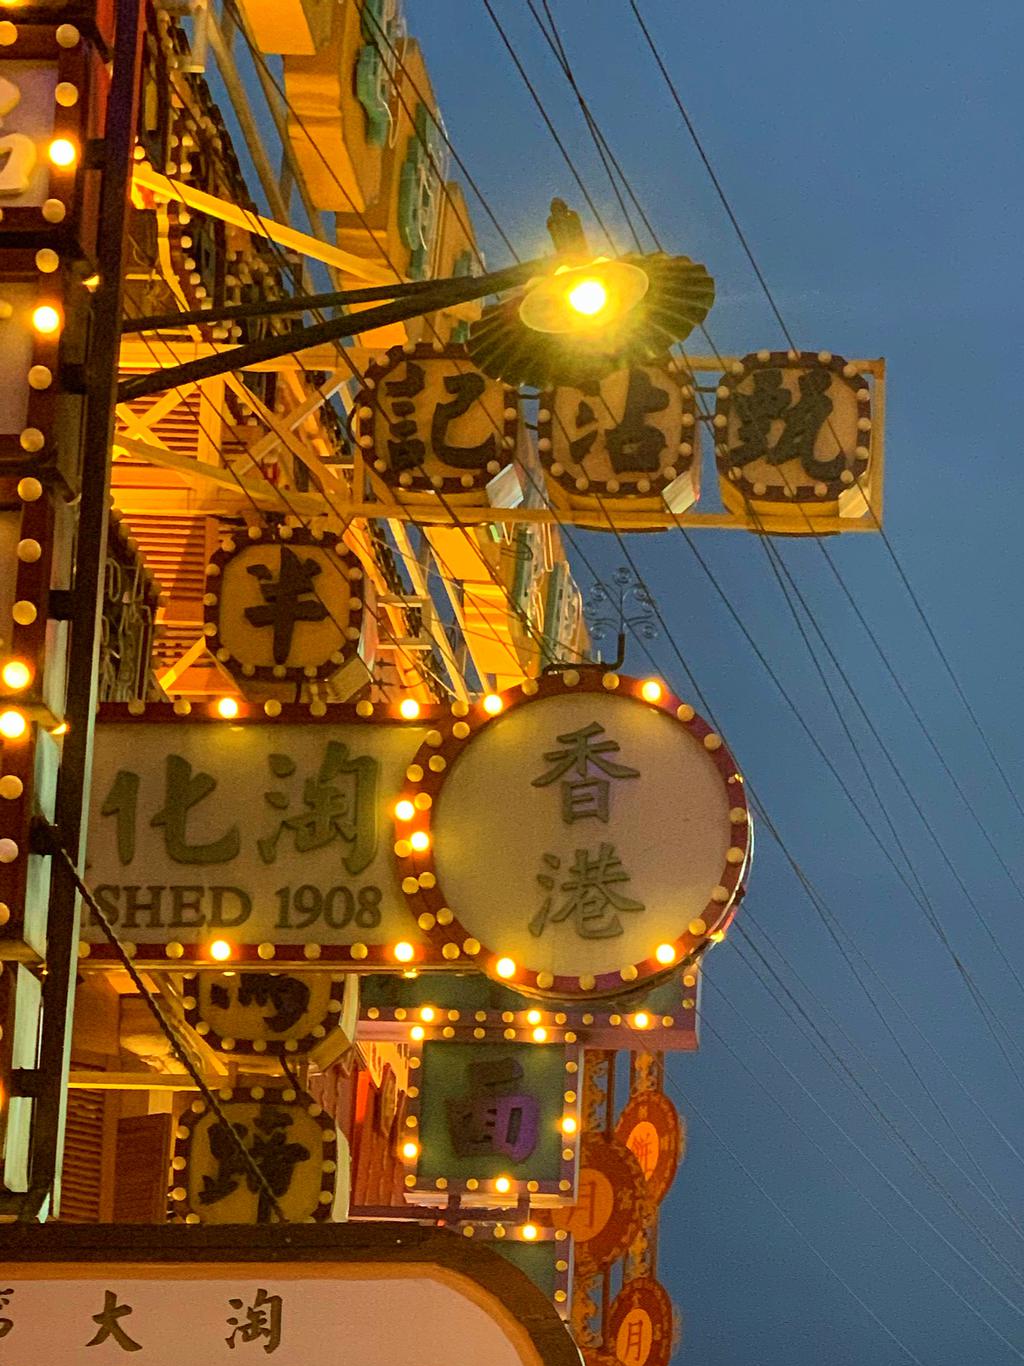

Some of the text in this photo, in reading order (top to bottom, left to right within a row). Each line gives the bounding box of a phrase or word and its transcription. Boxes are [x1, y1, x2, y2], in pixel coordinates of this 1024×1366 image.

[530, 721, 645, 942] 香港
[274, 885, 383, 929] 1908
[0, 1288, 283, 1354] 淘大
